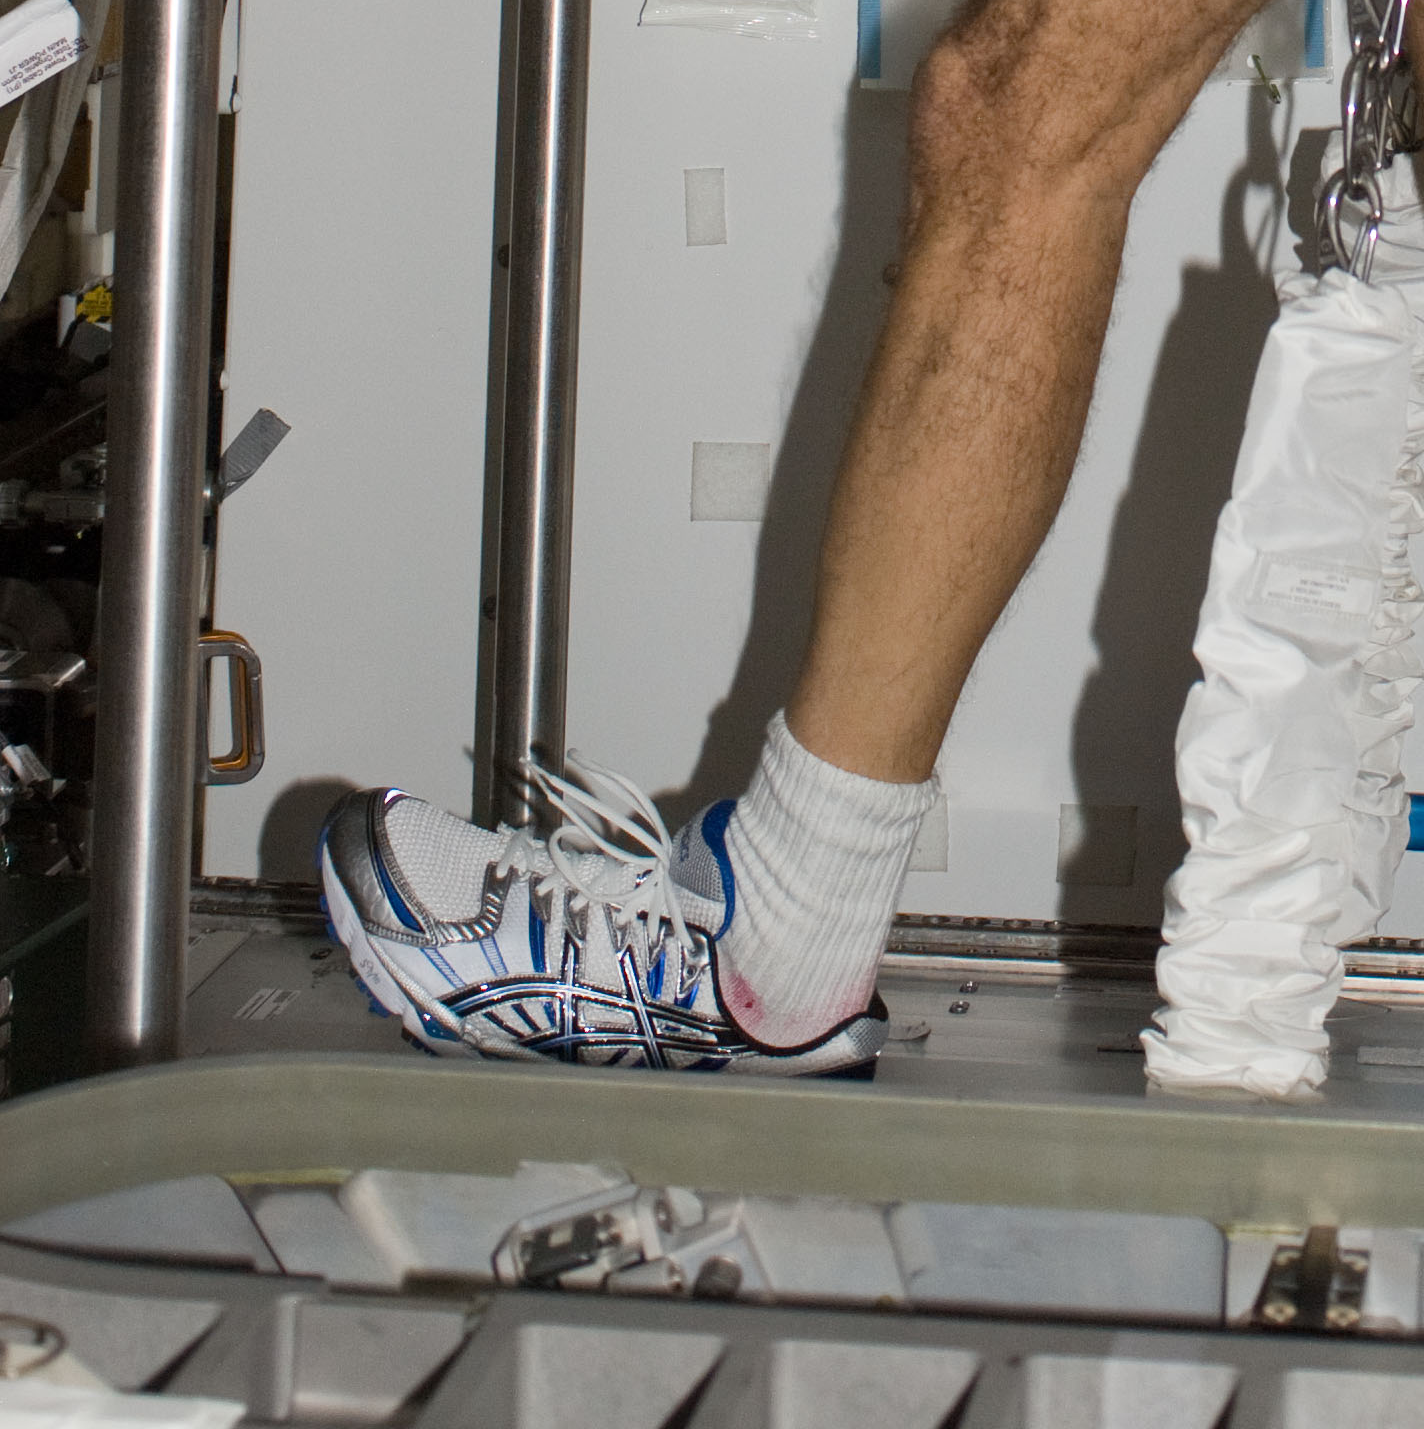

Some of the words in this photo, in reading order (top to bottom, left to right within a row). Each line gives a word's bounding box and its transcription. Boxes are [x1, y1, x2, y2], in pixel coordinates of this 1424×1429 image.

[46, 36, 68, 52] MAIN
[53, 44, 72, 56] Total
[17, 49, 47, 68] POWER
[23, 54, 53, 73] Organic
[43, 56, 67, 72] Power
[22, 69, 44, 84] Cable
